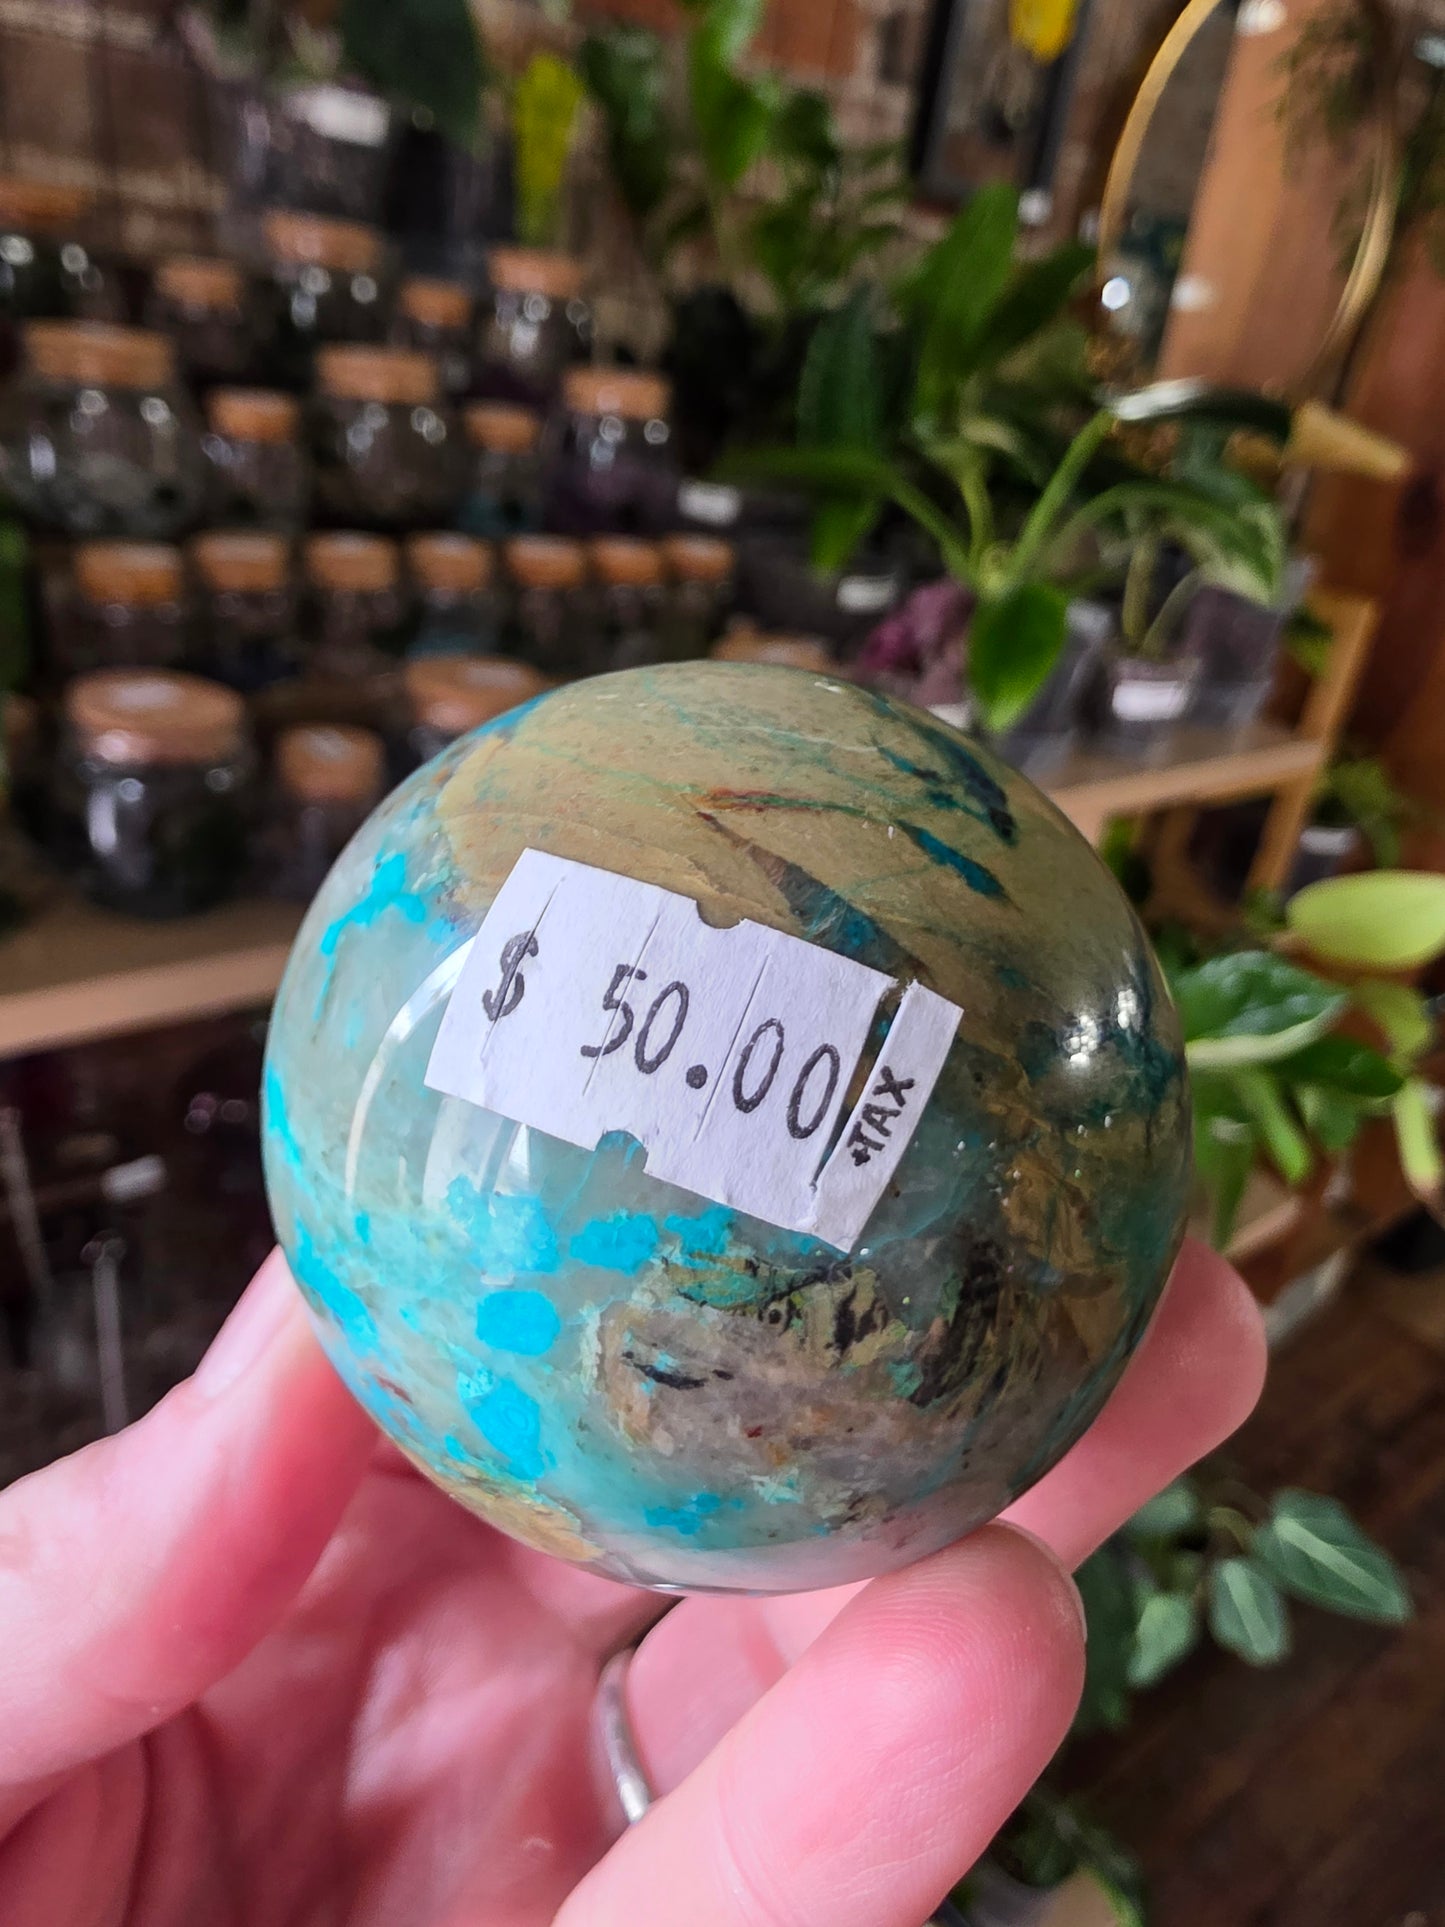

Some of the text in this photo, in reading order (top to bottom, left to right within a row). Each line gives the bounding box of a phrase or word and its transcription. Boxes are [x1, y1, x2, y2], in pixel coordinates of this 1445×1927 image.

[482, 929, 841, 1140] $ 50.00
[847, 1065, 915, 1167] +TAX
